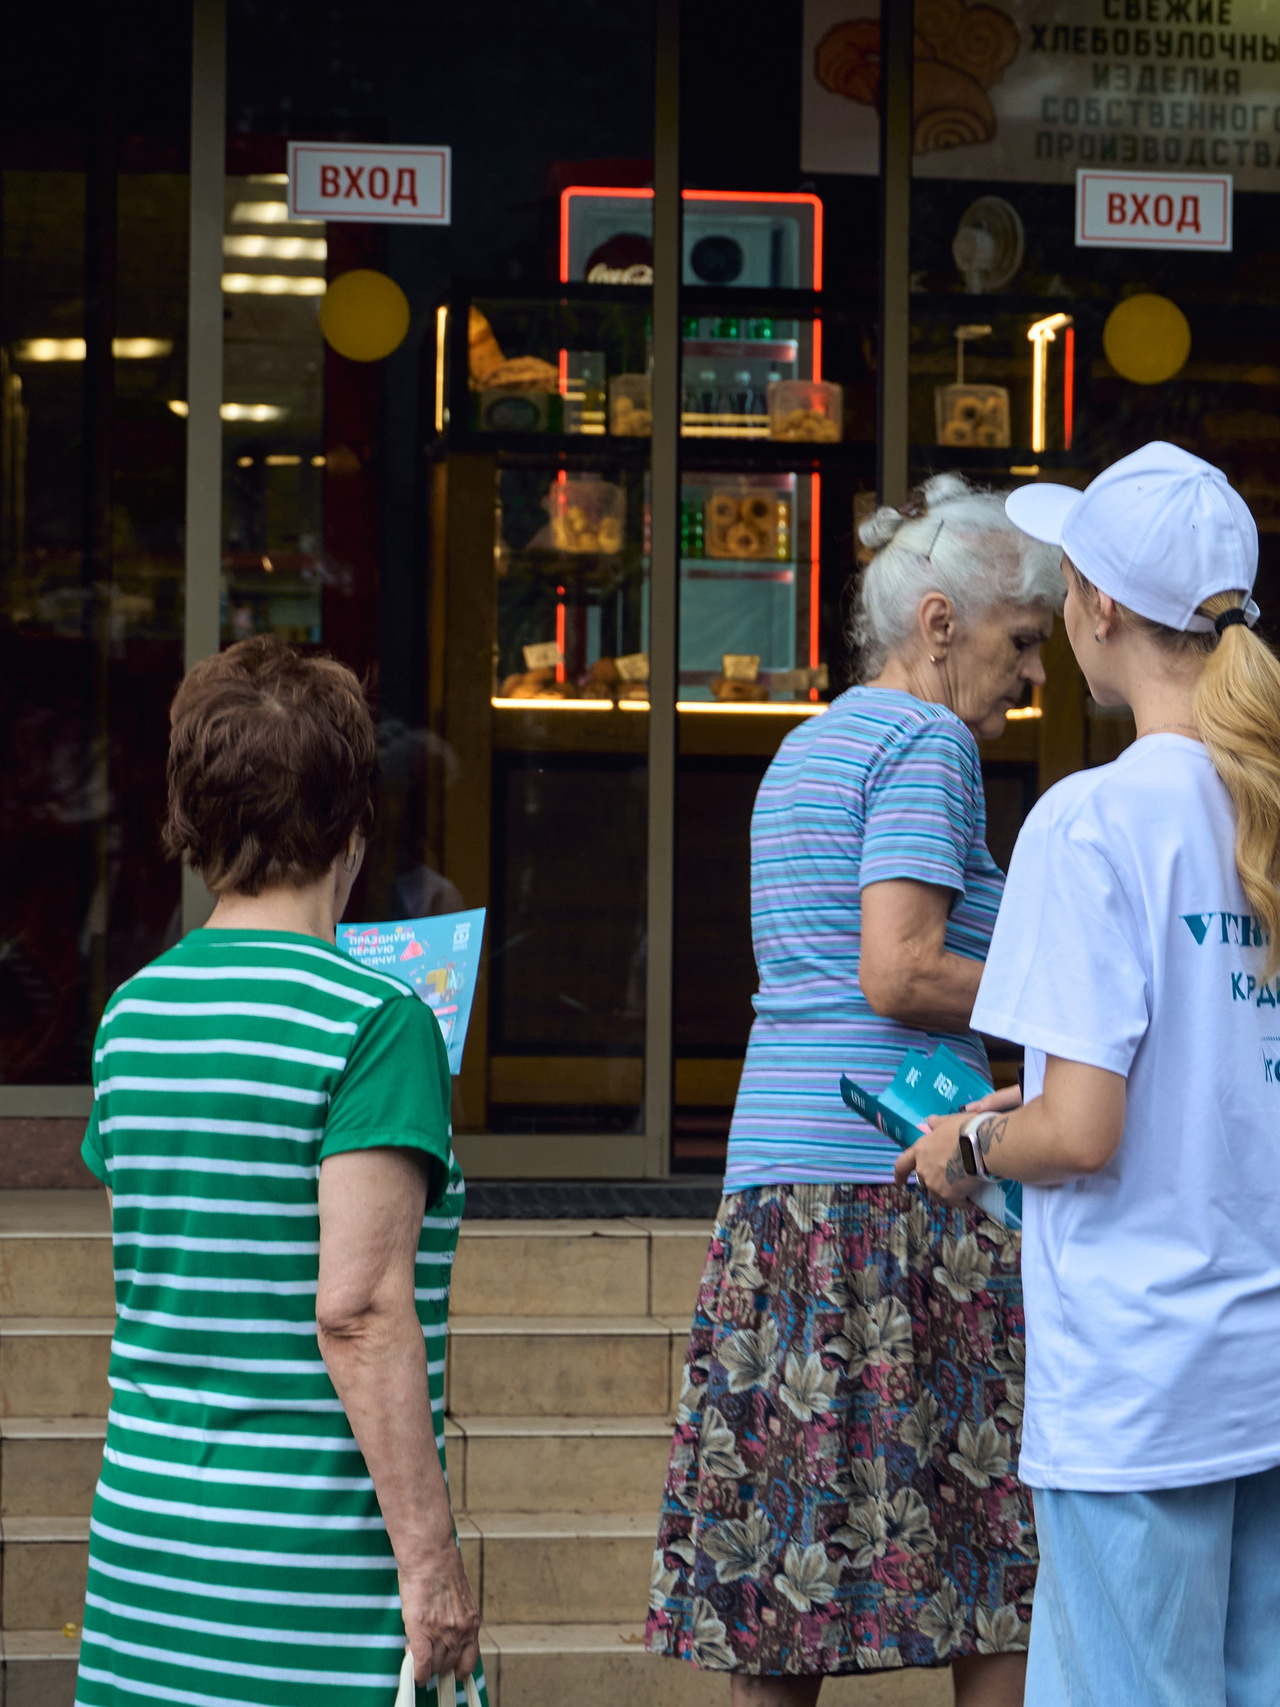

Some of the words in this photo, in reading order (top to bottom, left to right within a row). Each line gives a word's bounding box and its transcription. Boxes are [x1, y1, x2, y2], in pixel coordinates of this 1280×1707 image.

[1103, 0, 1232, 25] СВЕЖИЕ
[1091, 63, 1242, 96] ИЗДЕЛИЯ
[320, 165, 417, 207] ВХОД
[1107, 192, 1200, 233] ВХОД
